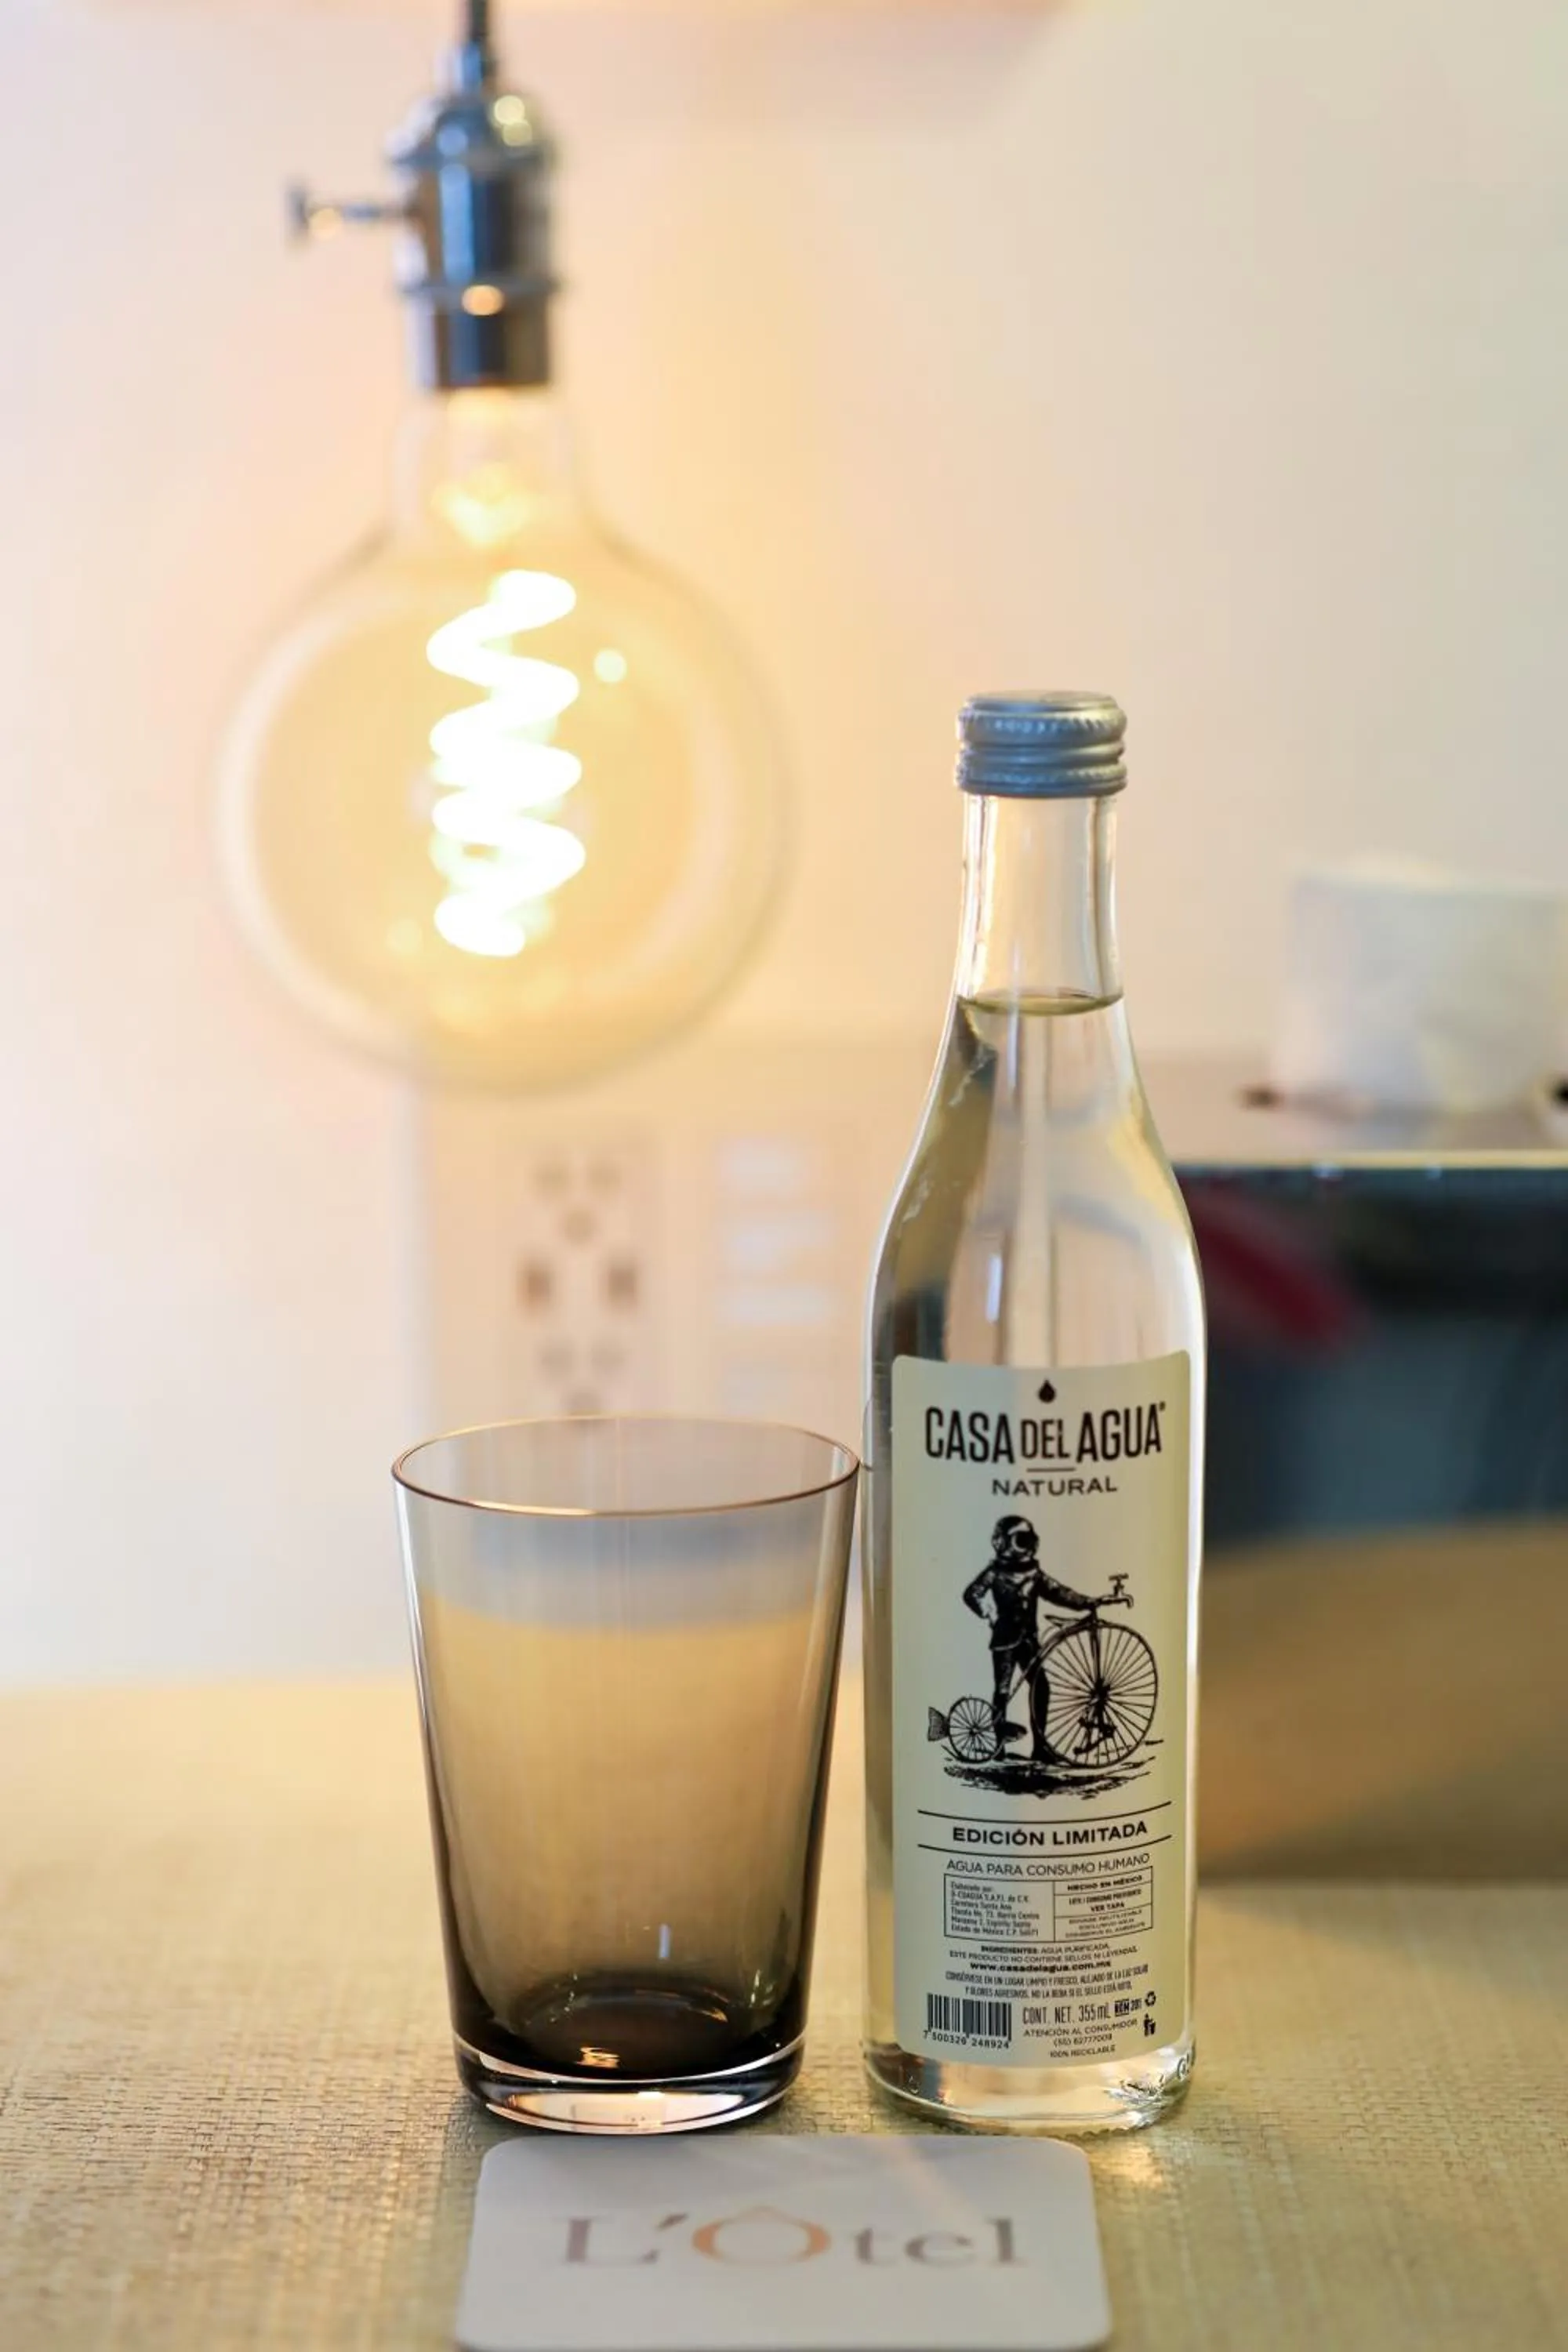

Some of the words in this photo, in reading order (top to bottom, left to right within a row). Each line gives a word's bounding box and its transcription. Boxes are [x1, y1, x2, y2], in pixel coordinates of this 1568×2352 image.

[925, 1406, 1015, 1464] CASA
[1021, 1419, 1070, 1459] DEL
[992, 1476, 1118, 1497] NATURAL
[953, 1827, 1044, 1846] EDICIÓN
[1053, 1821, 1148, 1846] LIMITADA
[946, 1859, 983, 1873] AGUA
[987, 1863, 1023, 1875] PARA
[1026, 1862, 1095, 1875] CONSUMO
[1098, 1853, 1150, 1871] HUMANO
[1113, 1875, 1142, 1885] MÉXICO
[1107, 1901, 1125, 1910] TAPA
[949, 1950, 966, 1958] ESTE
[968, 1953, 1008, 1962] PRODUCTO
[1064, 1953, 1091, 1962] SELLOS
[970, 1961, 1111, 1973] www.casadelagua.com.mx
[1022, 2006, 1051, 2024] CONT.
[1054, 2005, 1075, 2024] NET.
[1023, 2026, 1069, 2037] ATENCIÓN
[1071, 2026, 1082, 2034] AL
[1085, 2019, 1138, 2034] CONSUMIDOR
[971, 2038, 1009, 2049] 248924
[1071, 2045, 1116, 2056] RECICLABLE
